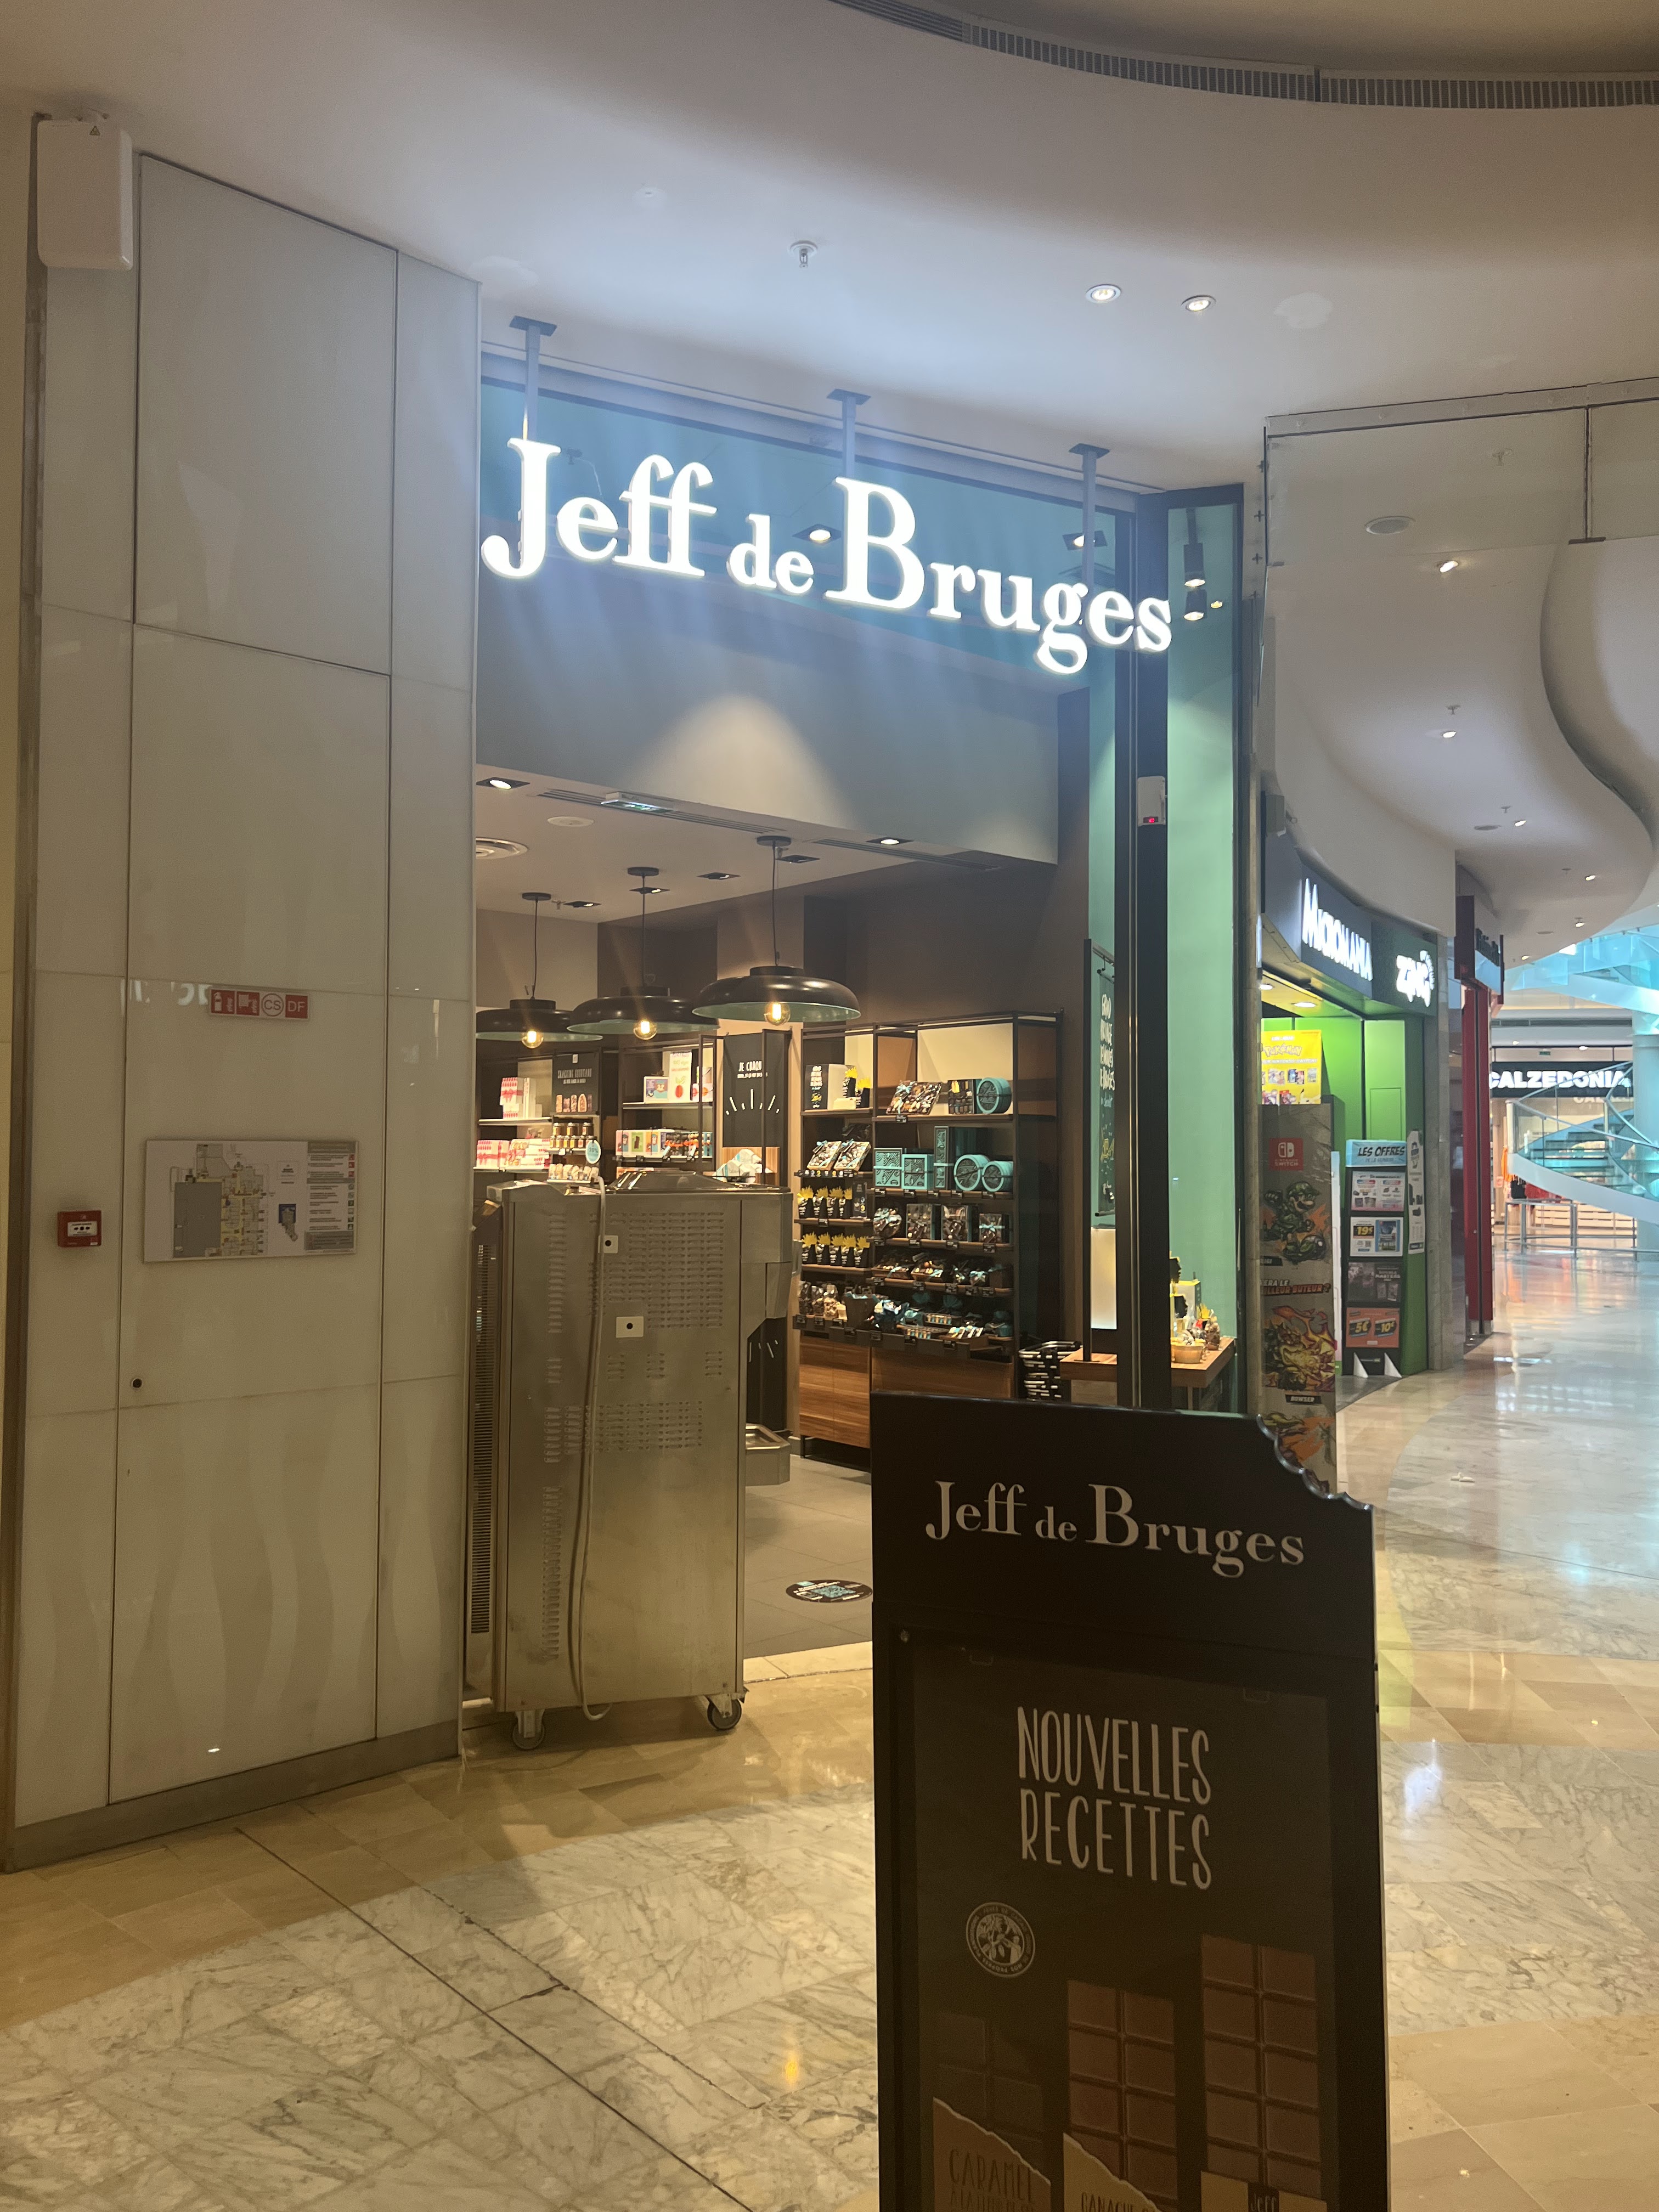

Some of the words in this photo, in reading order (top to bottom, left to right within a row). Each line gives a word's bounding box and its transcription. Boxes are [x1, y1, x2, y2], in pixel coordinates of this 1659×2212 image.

[480, 437, 718, 579] Jeff
[726, 514, 815, 595] de
[825, 476, 1173, 675] Bruges
[1302, 878, 1373, 981] MICROMANIA
[264, 1000, 281, 1011] CS
[288, 1001, 305, 1012] DF
[746, 1060, 762, 1071] CRAQU
[1489, 1070, 1632, 1089] CALZEDONIA
[1358, 1147, 1373, 1156] LES
[1375, 1146, 1405, 1156] OFFRES
[925, 1480, 1027, 1541] Jeff
[1035, 1506, 1078, 1542] de
[1085, 1483, 1304, 1578] Bruges
[1017, 1706, 1212, 1805] NOUVELLES
[1019, 1787, 1212, 1890] RECETTES
[949, 2148, 1036, 2204] CARAMEL
